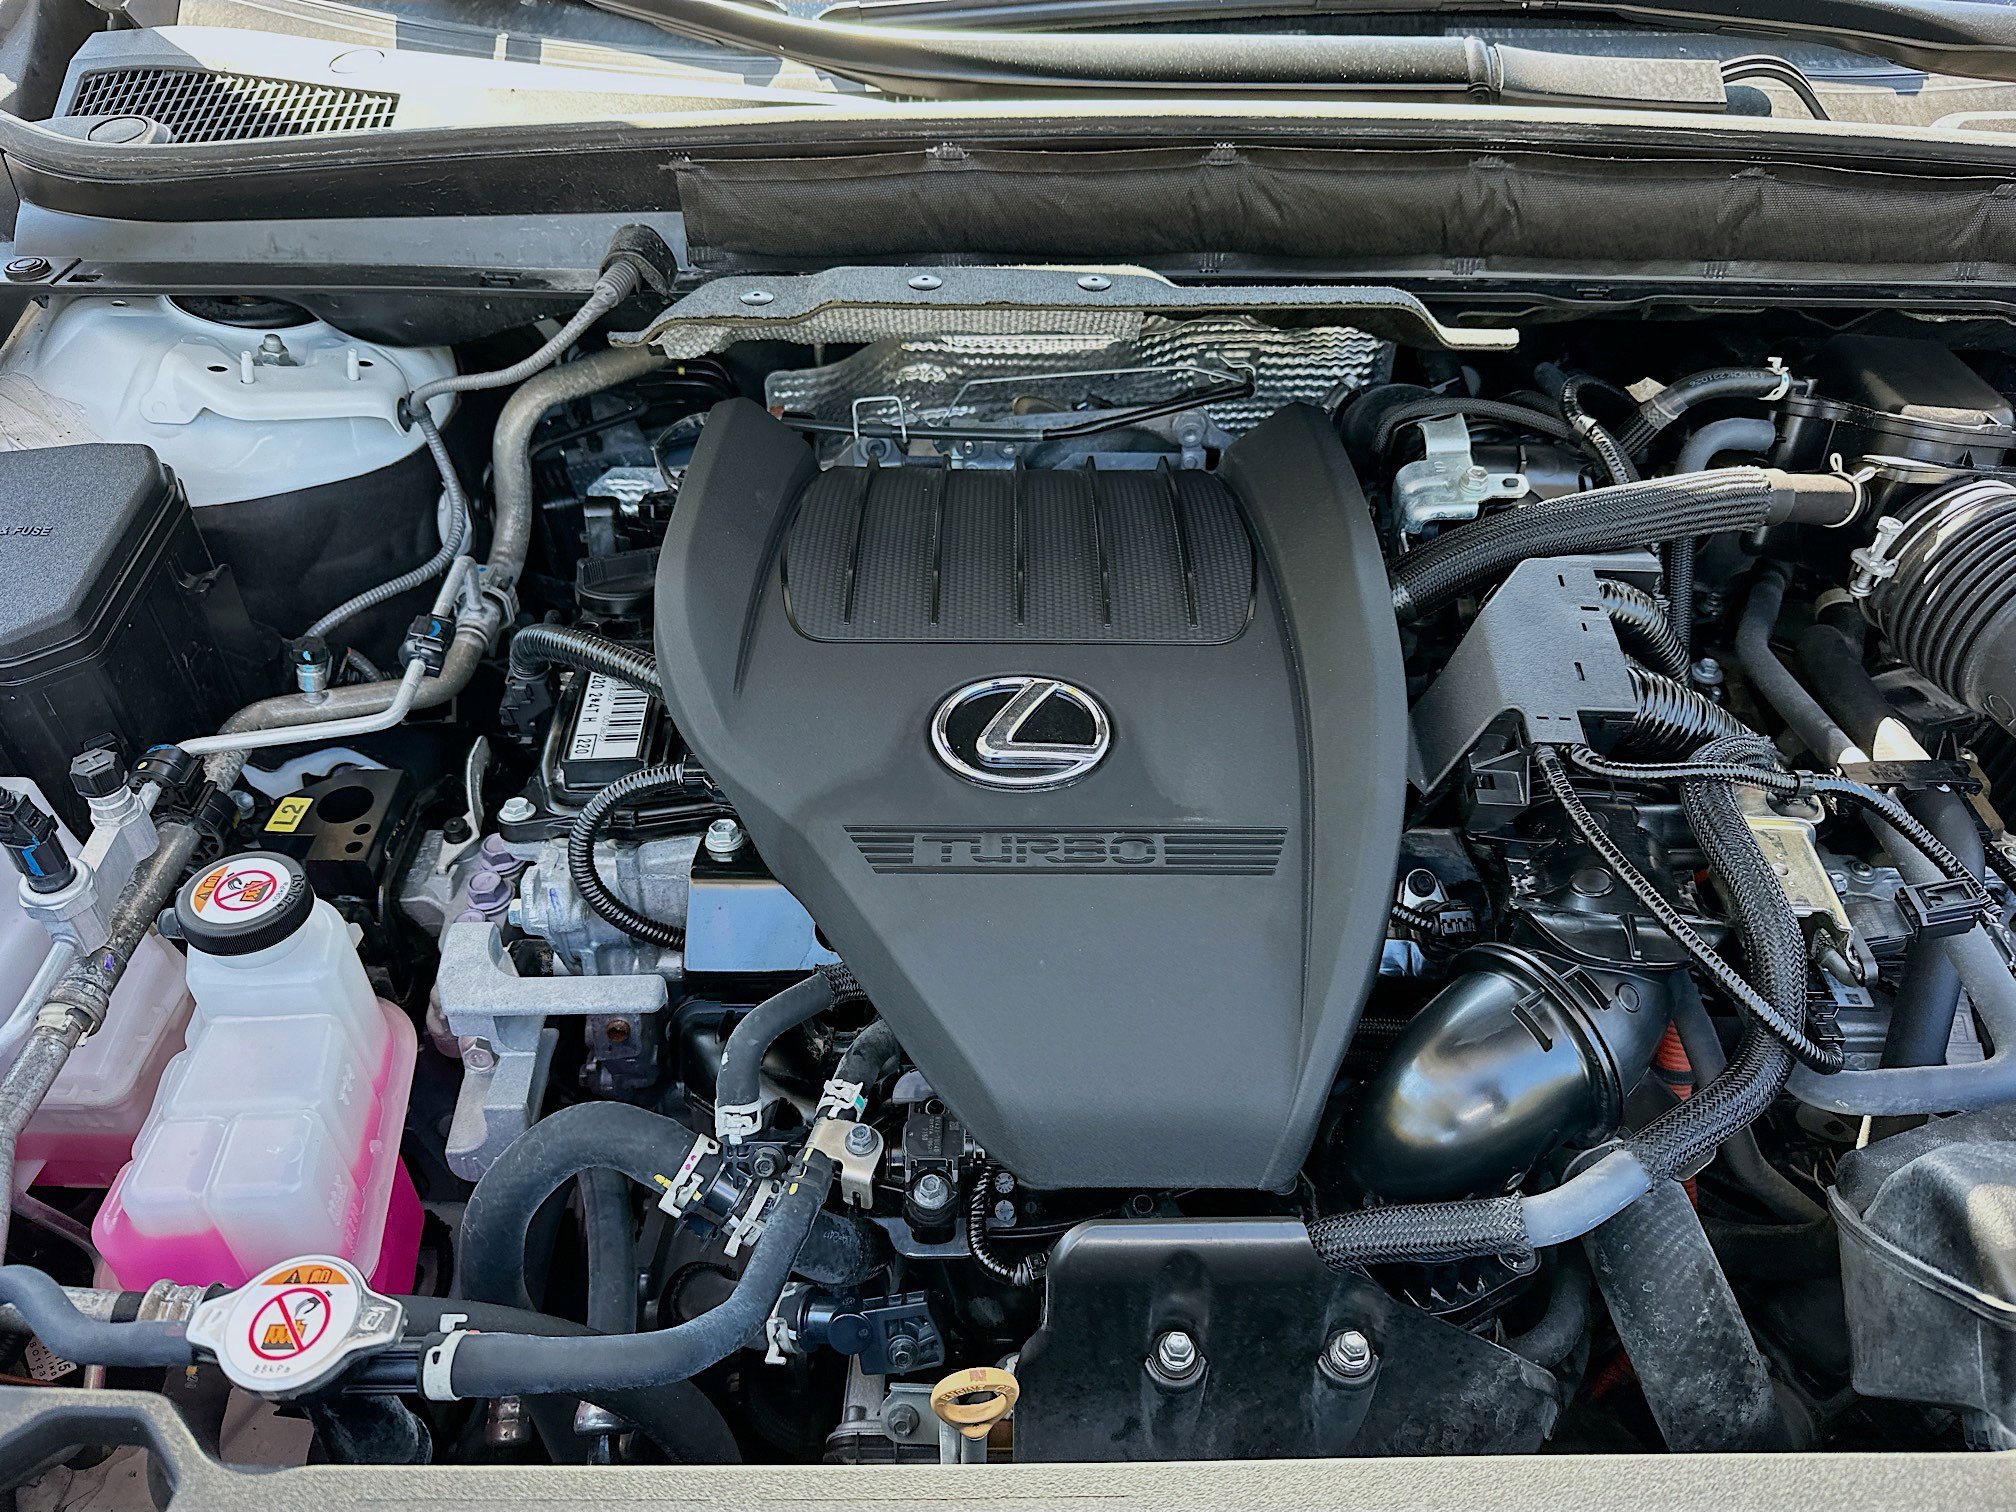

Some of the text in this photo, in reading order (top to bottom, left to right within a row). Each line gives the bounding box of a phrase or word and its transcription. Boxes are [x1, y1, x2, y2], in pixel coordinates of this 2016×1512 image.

[13, 526, 53, 537] FUSE
[574, 738, 592, 755] 220
[273, 804, 305, 826] L2
[922, 835, 1158, 865] TURBO
[275, 874, 305, 912] DENSO
